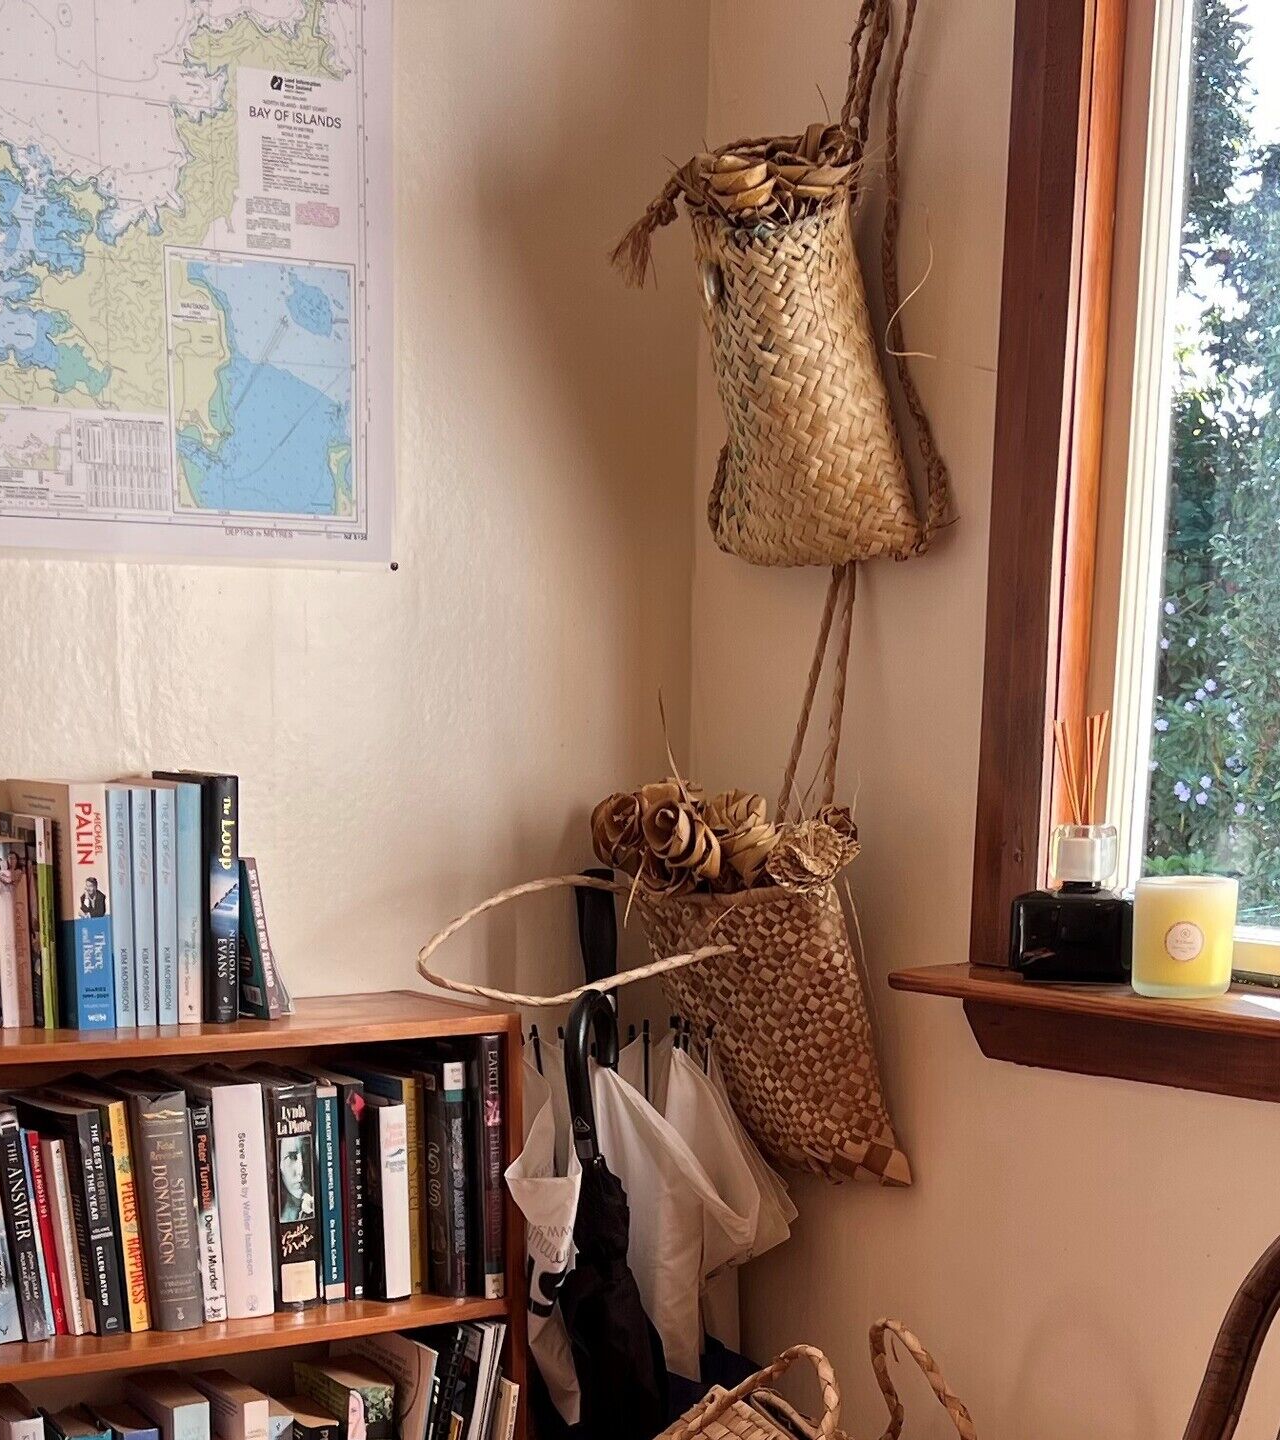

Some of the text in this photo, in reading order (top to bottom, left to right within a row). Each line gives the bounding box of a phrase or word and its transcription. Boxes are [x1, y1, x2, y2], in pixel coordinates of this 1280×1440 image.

[248, 105, 343, 130] BAY OF ISLANDS
[75, 802, 94, 865] PALIN
[93, 811, 103, 856] MICHAEL
[219, 797, 235, 870] The Loop
[82, 944, 94, 974] Back
[93, 930, 106, 970] There
[217, 938, 227, 978] EVANS
[228, 929, 236, 985] NICHOLAS
[120, 949, 129, 1012] KIM MORRISON
[142, 966, 150, 1011] MORRISON
[164, 965, 172, 1010] MORRISON
[90, 1123, 102, 1170] THE BEST
[6, 1141, 31, 1241] THE ANSWER
[85, 1159, 98, 1221] OF THE YEAR
[151, 1165, 176, 1265] DONALDSON
[169, 1177, 190, 1249] STEPHEN
[237, 1132, 255, 1276] Steve Jobs Isaacson
[120, 1181, 145, 1305] PIECES HAPPINESS
[204, 1214, 218, 1290] Denial Murder
[98, 1274, 109, 1306] DATLOW
